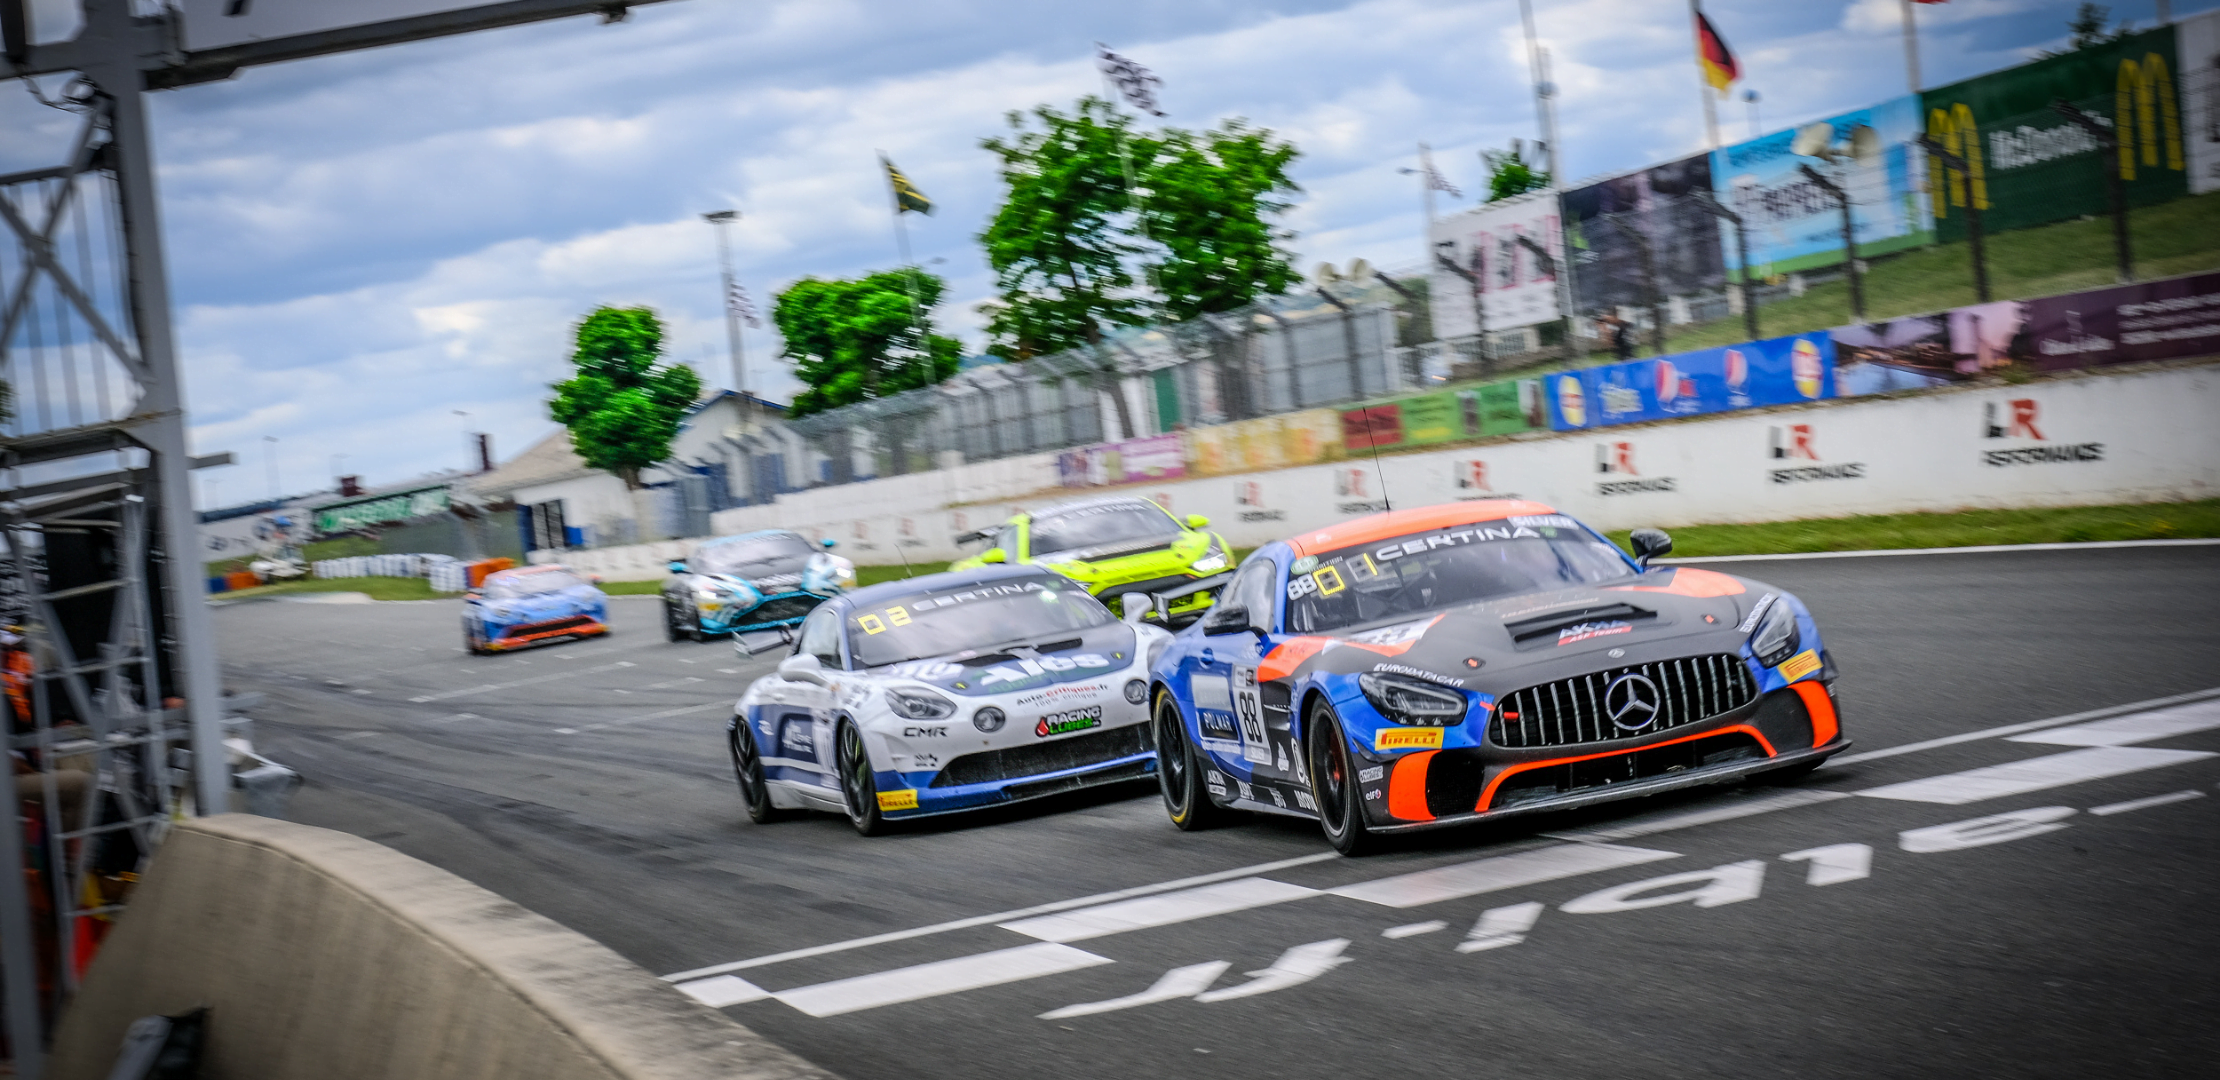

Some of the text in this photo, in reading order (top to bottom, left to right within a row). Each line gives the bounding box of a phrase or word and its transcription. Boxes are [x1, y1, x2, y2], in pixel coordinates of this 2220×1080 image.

[1375, 526, 1540, 561] CERTINA
[911, 581, 1046, 612] CERTINA
[1287, 573, 1317, 600] 88
[1374, 662, 1465, 688] EURODATACAR
[1047, 706, 1101, 726] RACING
[1049, 718, 1093, 734] LUBES
[1203, 712, 1233, 731] POLMAR
[1239, 691, 1262, 743] 88
[904, 727, 948, 737] CMR
[1381, 732, 1436, 745] PIRELLI
[1034, 781, 2220, 1021] -albi.fr
